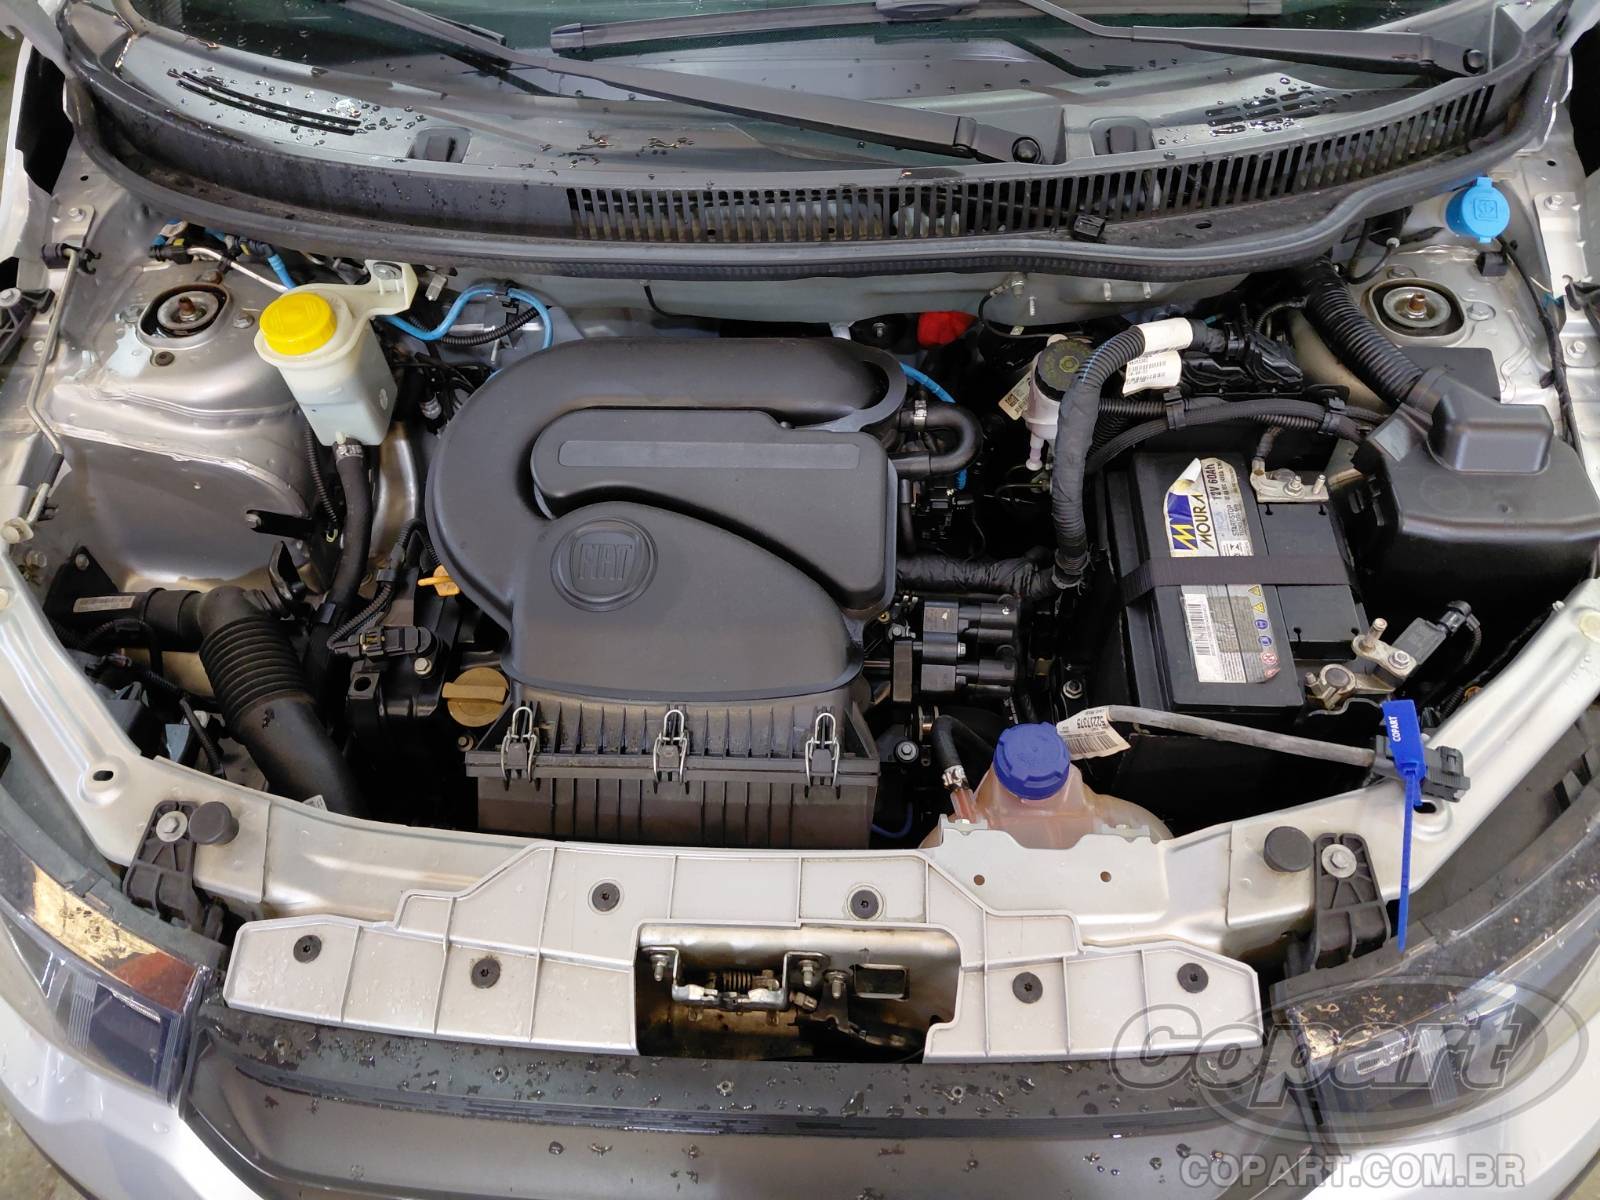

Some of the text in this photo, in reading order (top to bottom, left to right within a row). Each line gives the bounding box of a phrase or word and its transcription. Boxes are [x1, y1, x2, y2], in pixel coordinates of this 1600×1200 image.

[1206, 463, 1222, 501] 12V 60Ah
[1193, 494, 1214, 550] MOURA
[577, 543, 633, 581] FIAT
[1388, 715, 1402, 742] COPART
